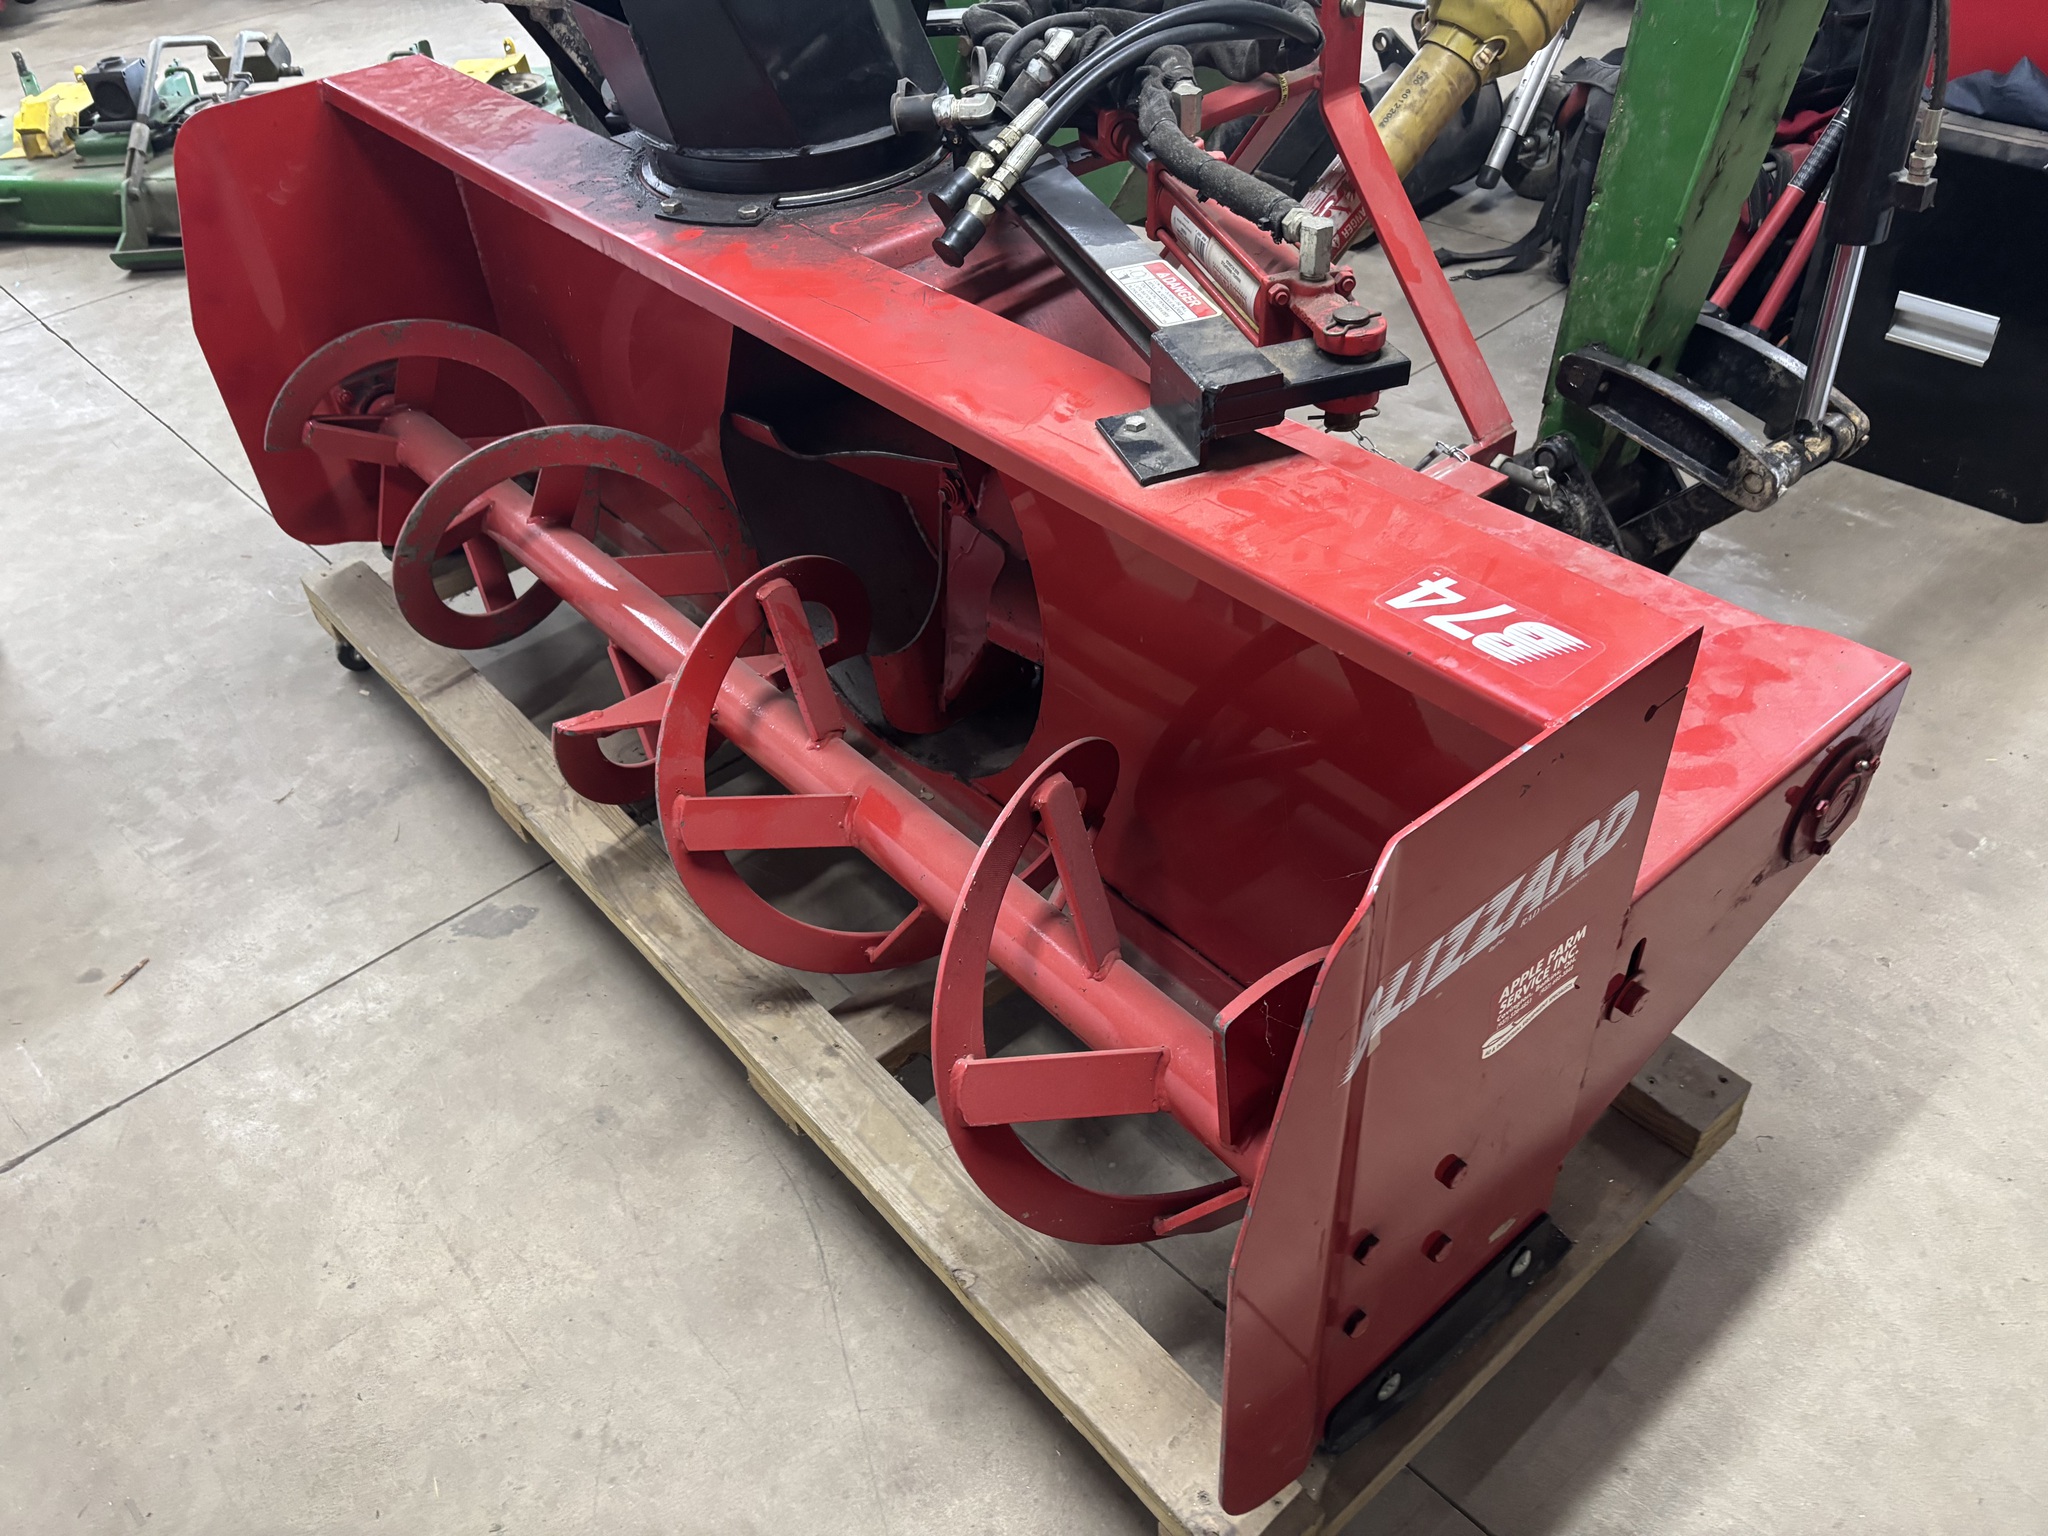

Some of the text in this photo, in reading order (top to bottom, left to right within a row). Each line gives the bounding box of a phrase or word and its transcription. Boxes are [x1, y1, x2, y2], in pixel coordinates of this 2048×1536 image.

[1341, 206, 1366, 238] ANGER
[1161, 275, 1202, 307] DANGER
[1498, 958, 1544, 1004] APPLE
[1547, 925, 1588, 965] FARM
[1498, 945, 1579, 1014] SERVICE INC.
